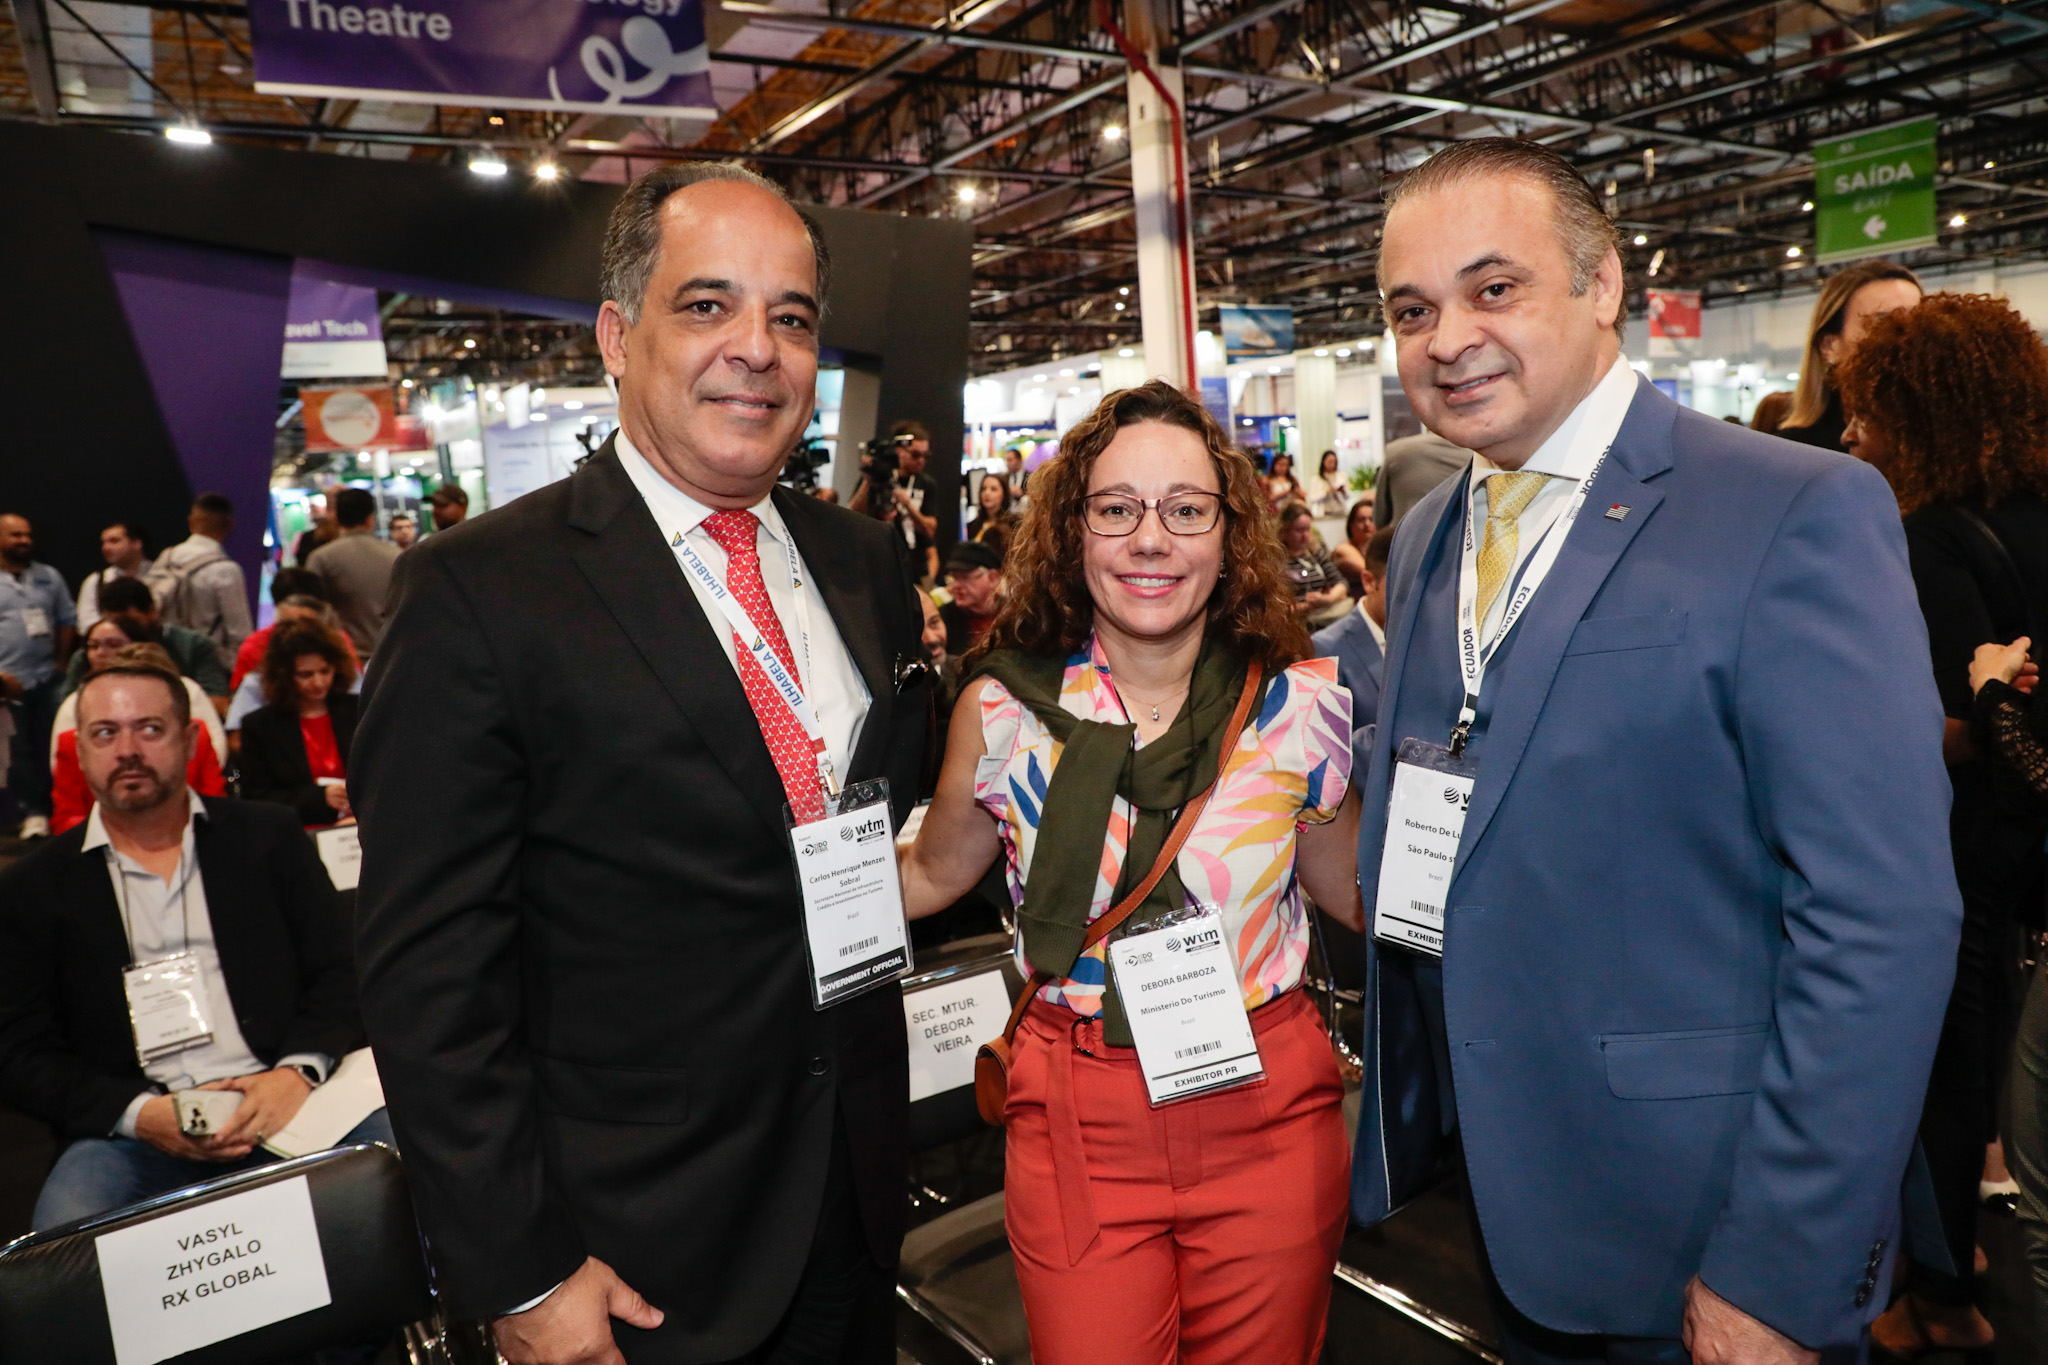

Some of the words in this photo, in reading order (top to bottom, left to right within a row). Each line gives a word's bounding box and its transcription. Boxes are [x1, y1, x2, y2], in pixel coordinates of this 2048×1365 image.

[281, 0, 451, 41] Theatre
[1834, 161, 1915, 195] SAÍDA
[322, 319, 368, 337] Tech
[682, 547, 727, 600] ILHABELA
[1463, 627, 1476, 679] ECUADOR
[763, 651, 803, 707] ILHABELA
[855, 819, 885, 836] wtm
[1405, 818, 1437, 833] Roberto
[1439, 827, 1450, 836] De
[1407, 844, 1422, 855] São
[1424, 848, 1447, 861] Paulo
[809, 873, 831, 884] Carlos
[831, 864, 861, 878] Henrique
[862, 856, 886, 868] Menzes
[839, 875, 861, 887] Sobral
[1428, 873, 1443, 881] Brazil
[1183, 929, 1219, 946] wtm
[820, 968, 871, 994] GOVERNMENT
[872, 955, 903, 974] OFFICIAL
[1141, 977, 1175, 992] DEBORA
[1176, 966, 1217, 983] BARBOZA
[912, 1008, 939, 1024] SEC.
[942, 997, 979, 1016] MTUR.
[1140, 1000, 1180, 1015] Ministerio
[1180, 997, 1192, 1005] Do
[1193, 988, 1226, 1002] Turismo
[924, 1016, 975, 1039] DÉBORA
[933, 1035, 973, 1054] VIEIRA
[1174, 1070, 1223, 1088] EXHIBITOR
[1225, 1066, 1238, 1076] PR
[177, 1222, 243, 1251] VASYL
[166, 1239, 262, 1281] ZHYGALO
[162, 1289, 190, 1311] RX
[195, 1262, 277, 1299] GLOBAL
